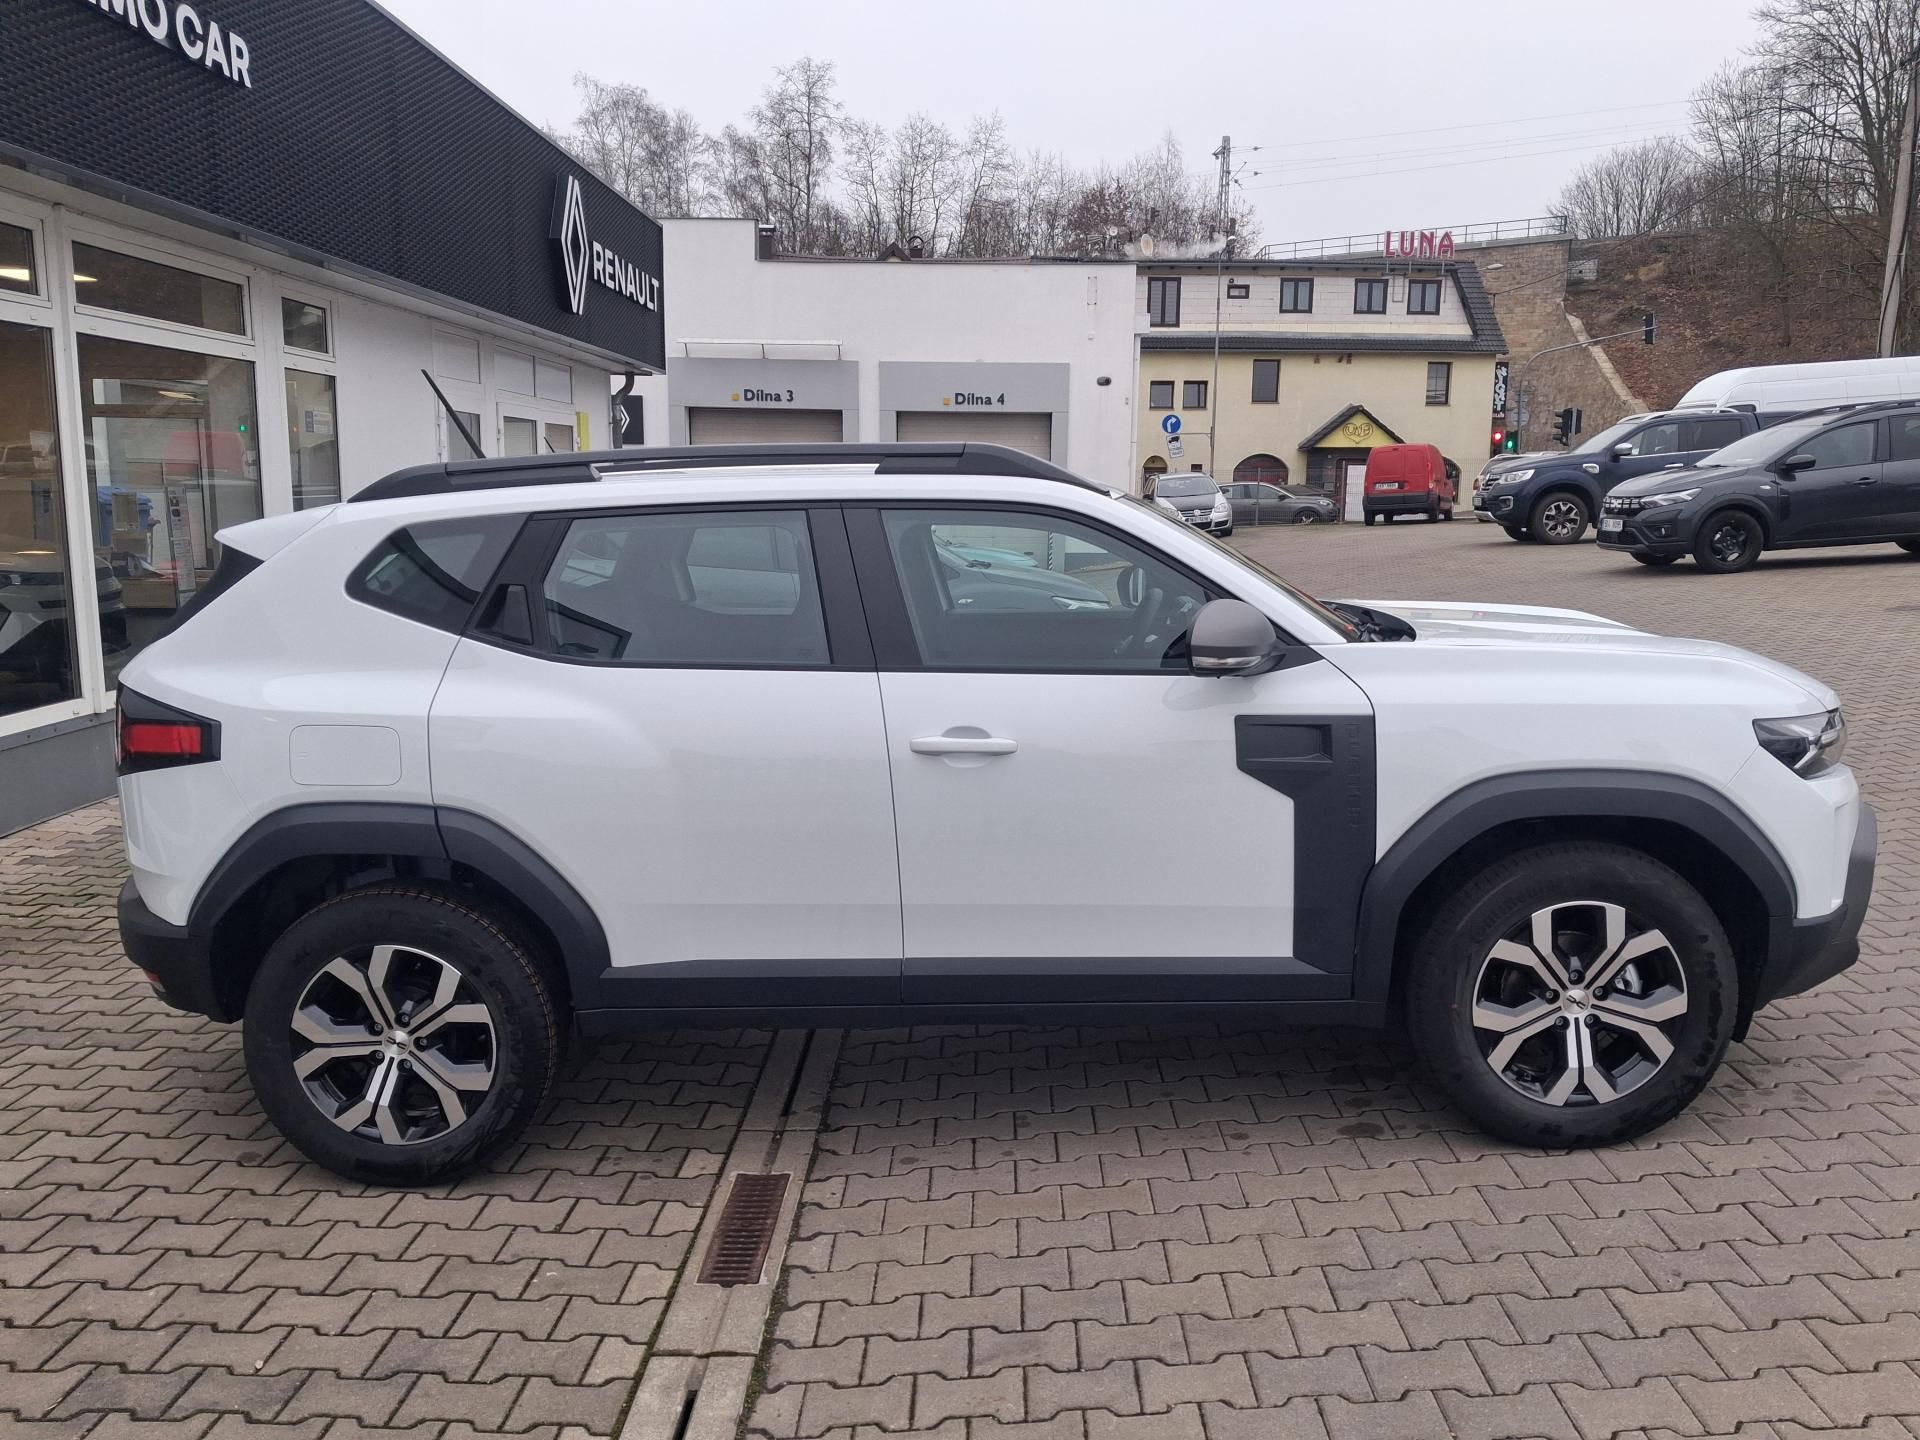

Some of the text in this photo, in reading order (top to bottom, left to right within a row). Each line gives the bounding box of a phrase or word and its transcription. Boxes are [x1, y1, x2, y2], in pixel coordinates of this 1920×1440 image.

[176, 4, 251, 88] CAR
[1383, 230, 1455, 259] LUNA
[593, 240, 659, 313] RENAULT
[743, 388, 794, 402] Dílna 3
[954, 392, 1005, 406] Dílna 4
